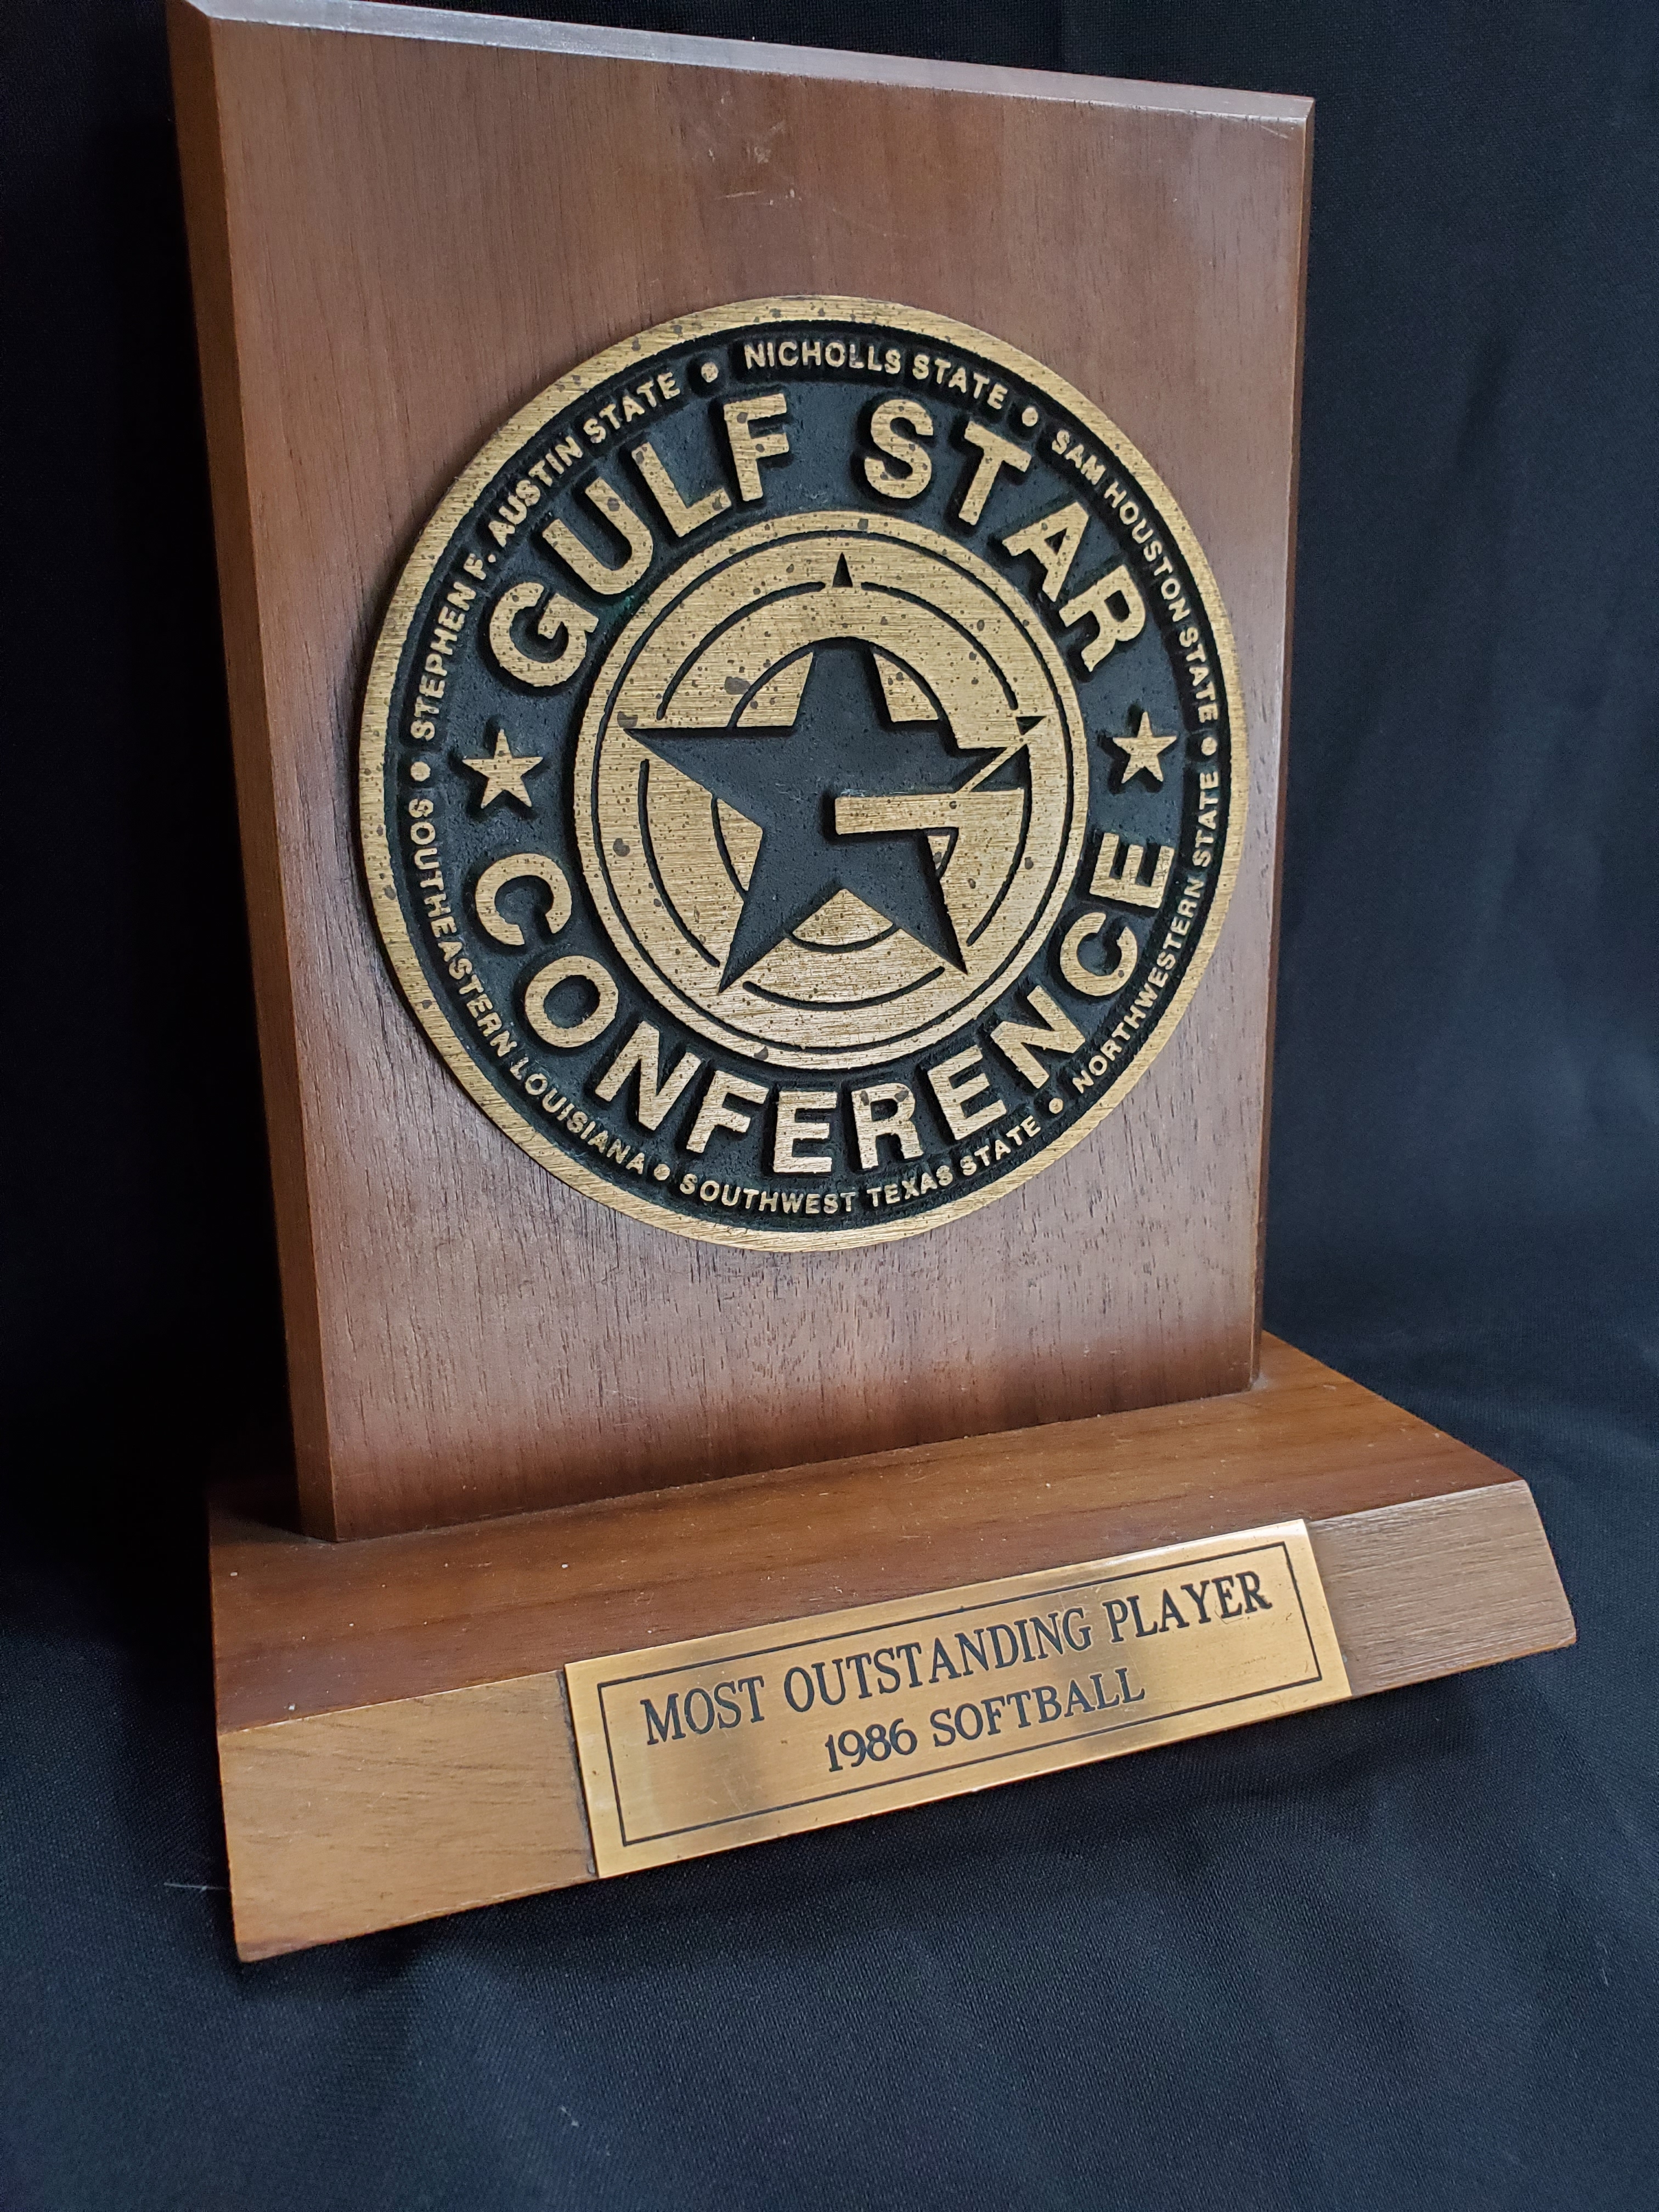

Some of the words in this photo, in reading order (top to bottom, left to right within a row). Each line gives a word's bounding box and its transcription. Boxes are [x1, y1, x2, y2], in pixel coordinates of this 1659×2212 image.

[744, 341, 901, 375] NICHOLLS
[912, 354, 1009, 410] STATE
[411, 582, 476, 740] STEPHEN
[464, 550, 496, 580] F.
[488, 437, 583, 546] AUSTIN
[584, 373, 680, 443] STATE
[489, 393, 789, 686] GULF
[865, 399, 1146, 672] STAR
[1052, 430, 1105, 486] SAM
[1104, 486, 1191, 622] HOUSTON
[1179, 627, 1219, 723] STATE
[409, 799, 517, 1056] SOUTHEASTERN
[510, 1059, 646, 1172] LOUISIANA
[475, 833, 1175, 1173] CONFERENCE
[1073, 879, 1205, 1094] NORTHWESTERN
[1197, 770, 1219, 867] STATE
[680, 1172, 856, 1214] SOUTHWEST
[867, 1167, 953, 1208] TEXAS
[960, 1118, 1041, 1176] STATE
[641, 1676, 766, 1745] MOST
[783, 1607, 1092, 1713] OUTSTANDING
[1103, 1570, 1272, 1643] PLAYER
[825, 1719, 917, 1772] 1986
[929, 1667, 1147, 1747] SOFTBALL
